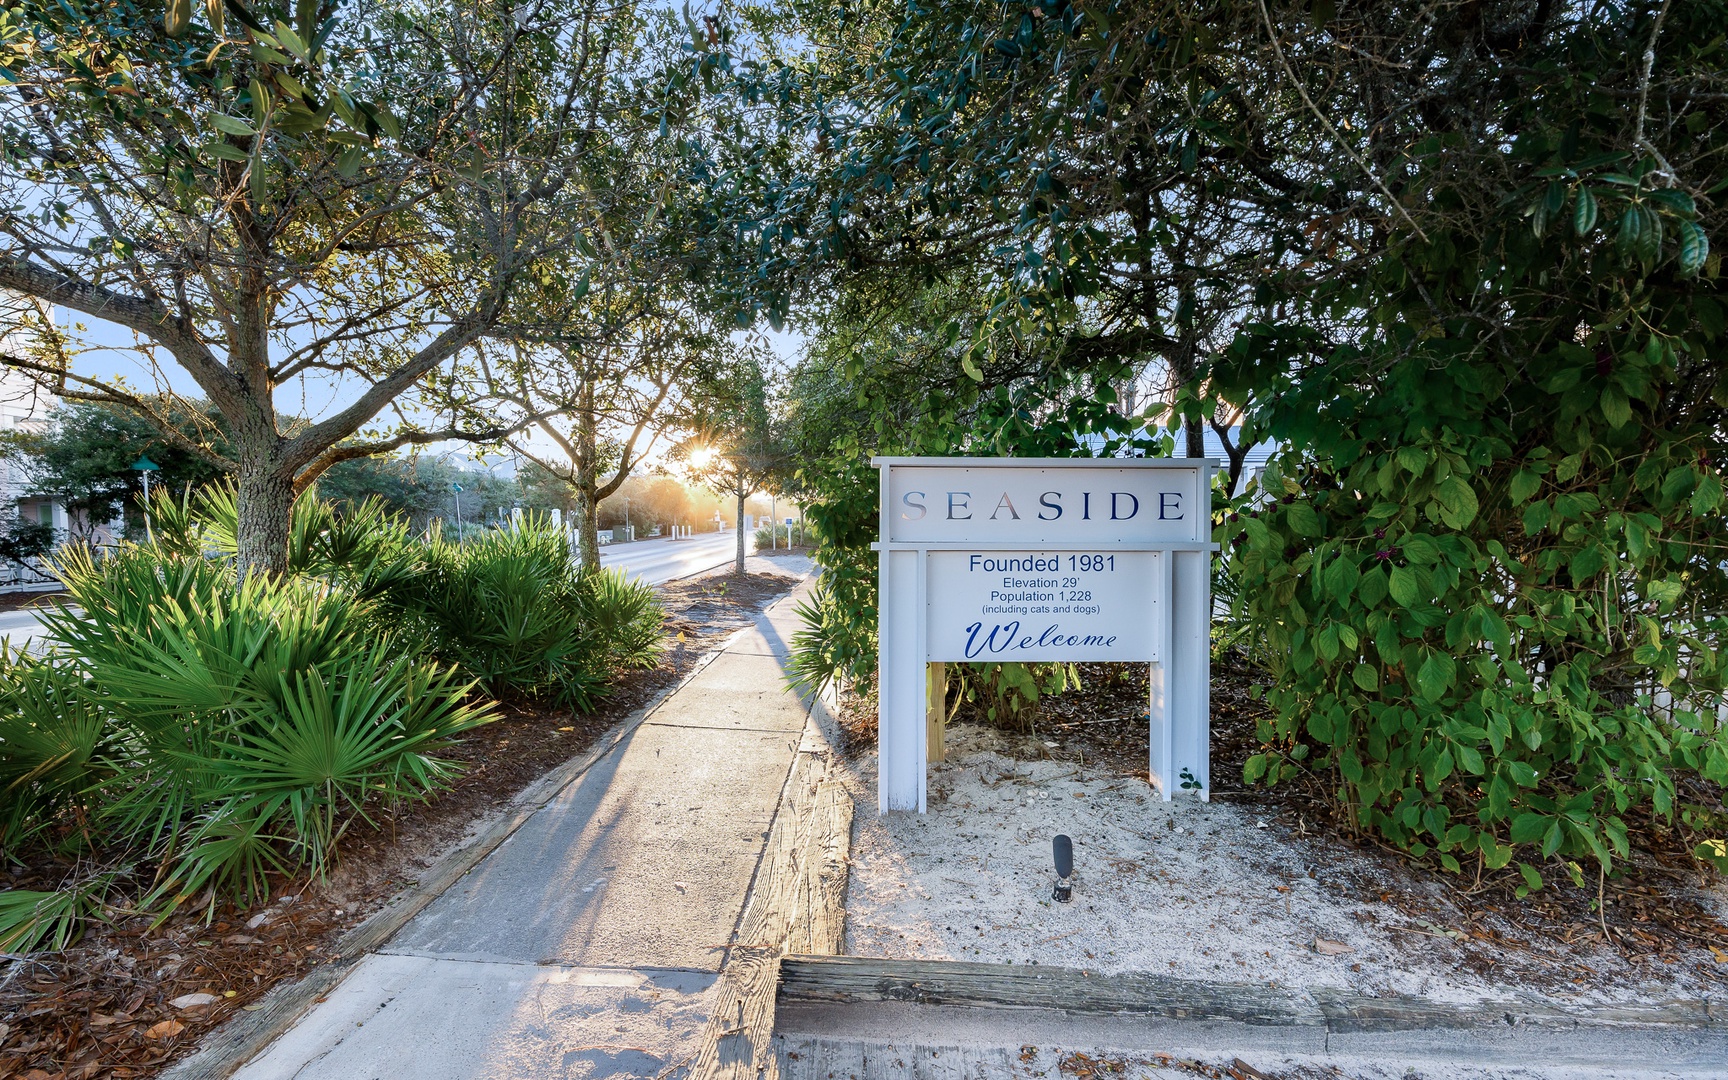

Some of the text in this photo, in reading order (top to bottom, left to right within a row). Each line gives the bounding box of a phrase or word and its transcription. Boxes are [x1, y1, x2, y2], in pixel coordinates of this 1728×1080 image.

[901, 490, 1185, 521] SEASIDE
[968, 554, 1115, 573] Founded 1981
[1003, 577, 1059, 589] Elevation
[990, 590, 1092, 604] Population 1,228
[981, 604, 1101, 616] (including cats and dogs)
[964, 620, 1117, 659] Welcome
